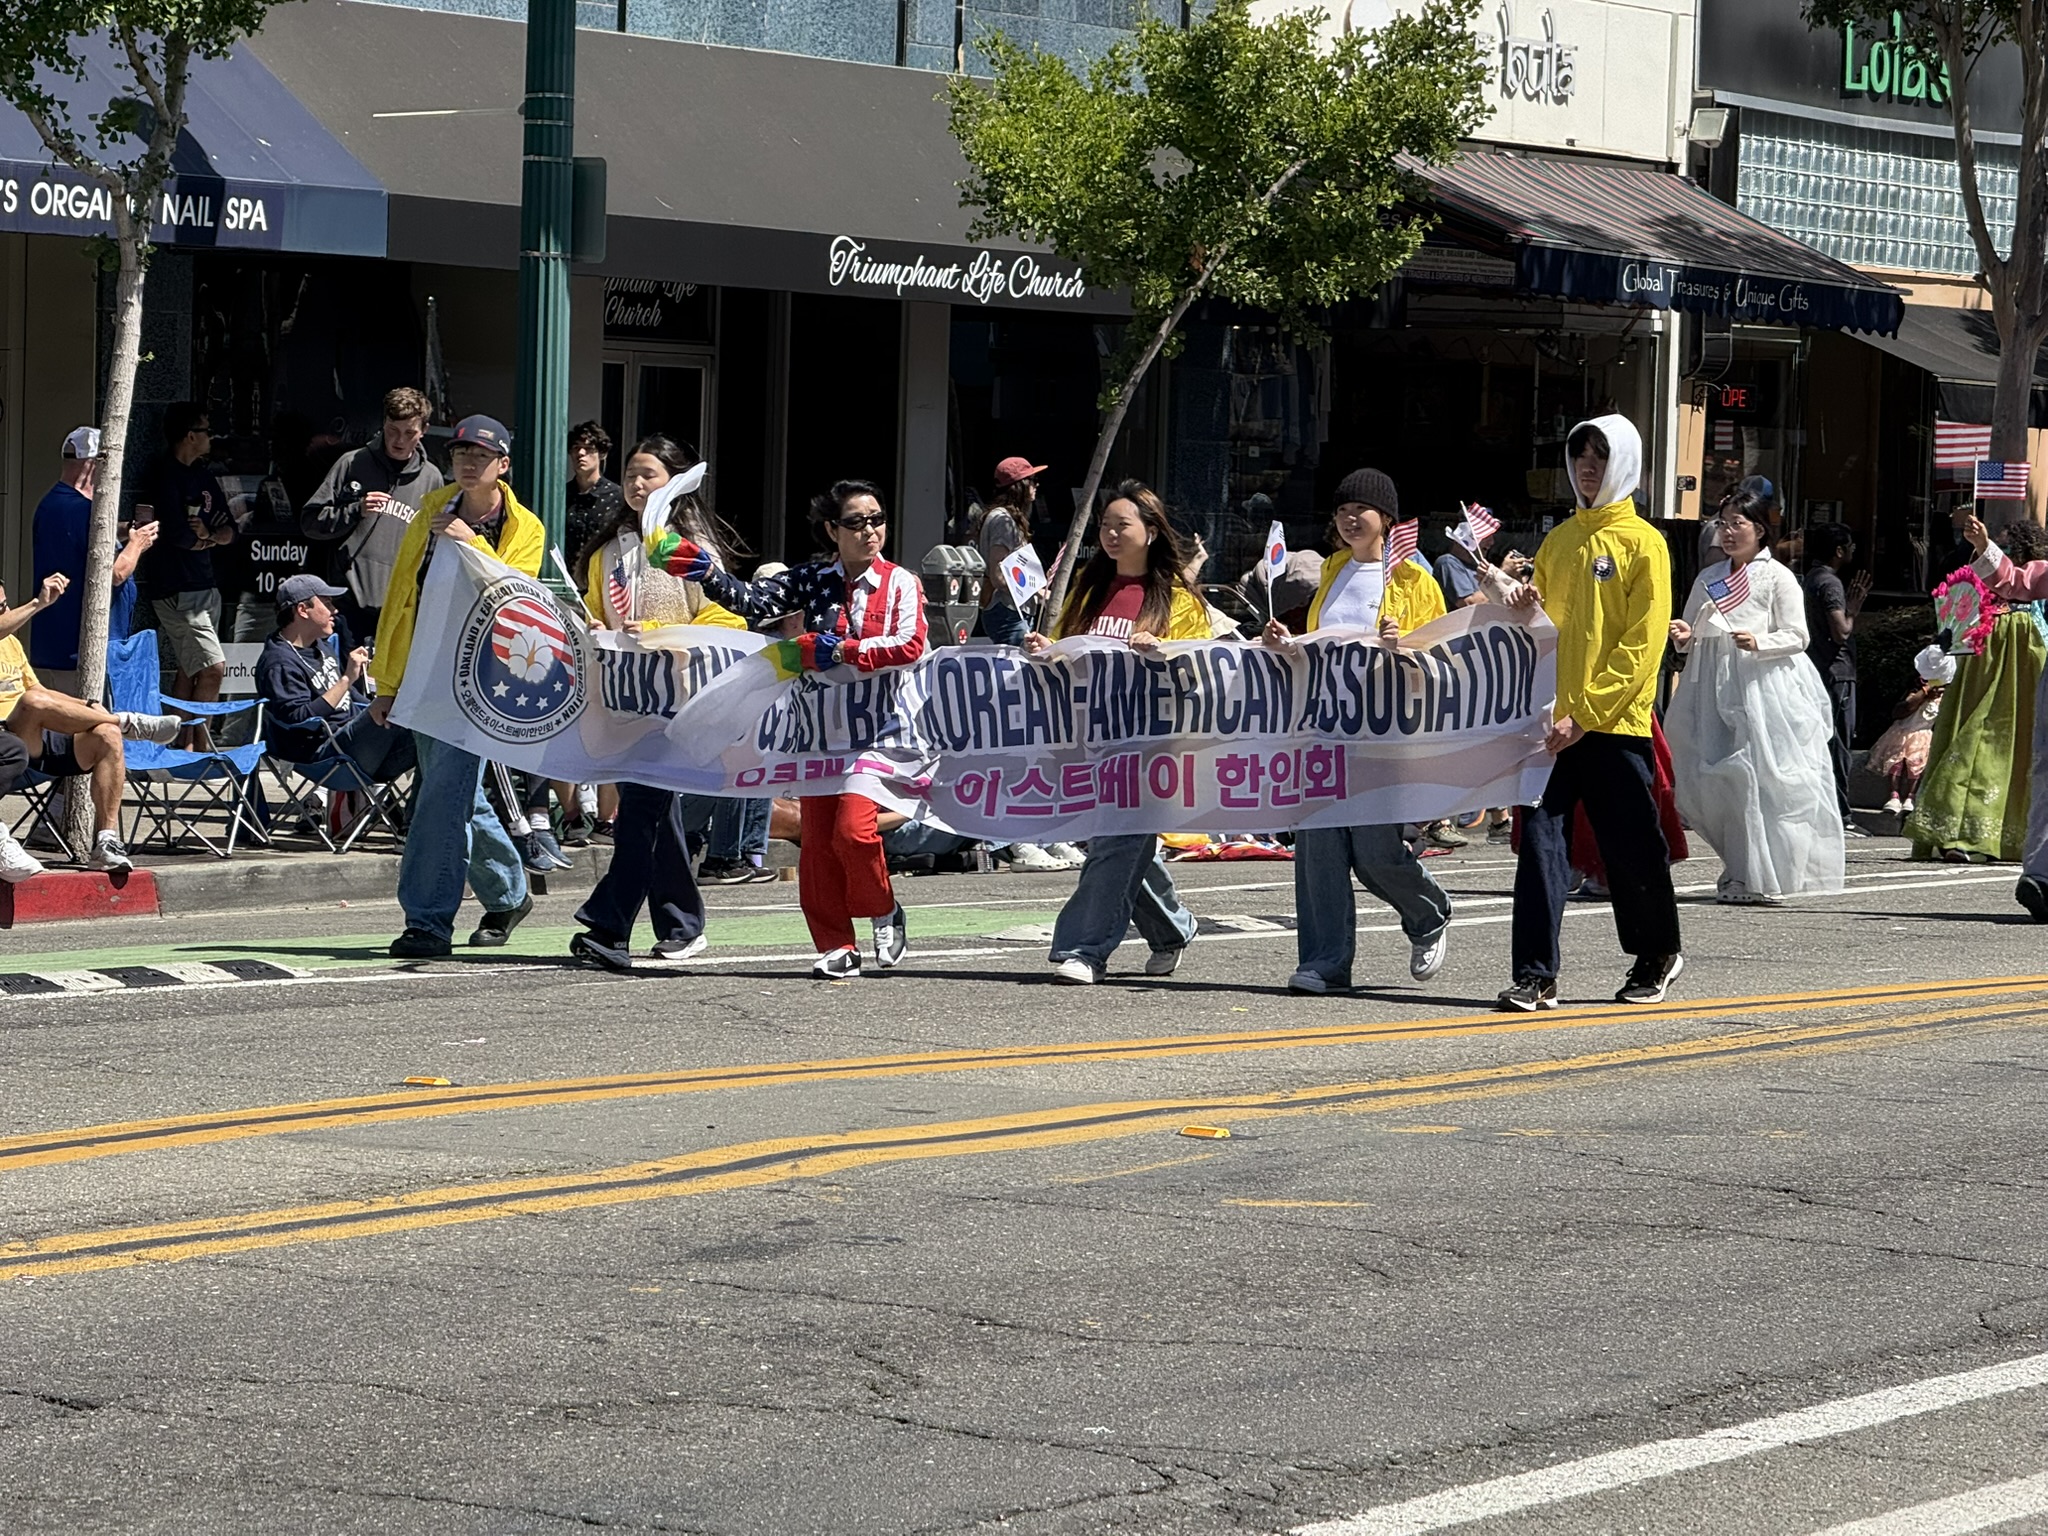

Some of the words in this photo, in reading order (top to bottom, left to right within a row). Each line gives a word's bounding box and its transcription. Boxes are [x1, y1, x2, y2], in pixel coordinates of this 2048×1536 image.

[162, 193, 214, 228] NAIL
[225, 197, 268, 231] SPA
[829, 235, 962, 296] Triumphant
[961, 250, 1006, 304] Life
[1008, 255, 1085, 299] Church
[1622, 263, 1663, 293] Global
[1666, 268, 1720, 299] Treasures
[1723, 282, 1731, 301] &
[1735, 278, 1776, 315] Unique
[1779, 284, 1809, 312] Gifts
[604, 295, 663, 327] Church
[251, 540, 308, 566] Sunday
[256, 572, 275, 593] 10
[480, 583, 513, 618] EAST-BAY
[510, 582, 541, 601] KOREAN
[478, 617, 487, 627] &
[460, 625, 479, 679] OAKLAND
[913, 646, 1293, 752] KOREAN-AMERICAN
[1297, 625, 1538, 736] ASSOCIATION
[954, 752, 1195, 818] 이스트베이
[1215, 744, 1348, 808] 한인회
